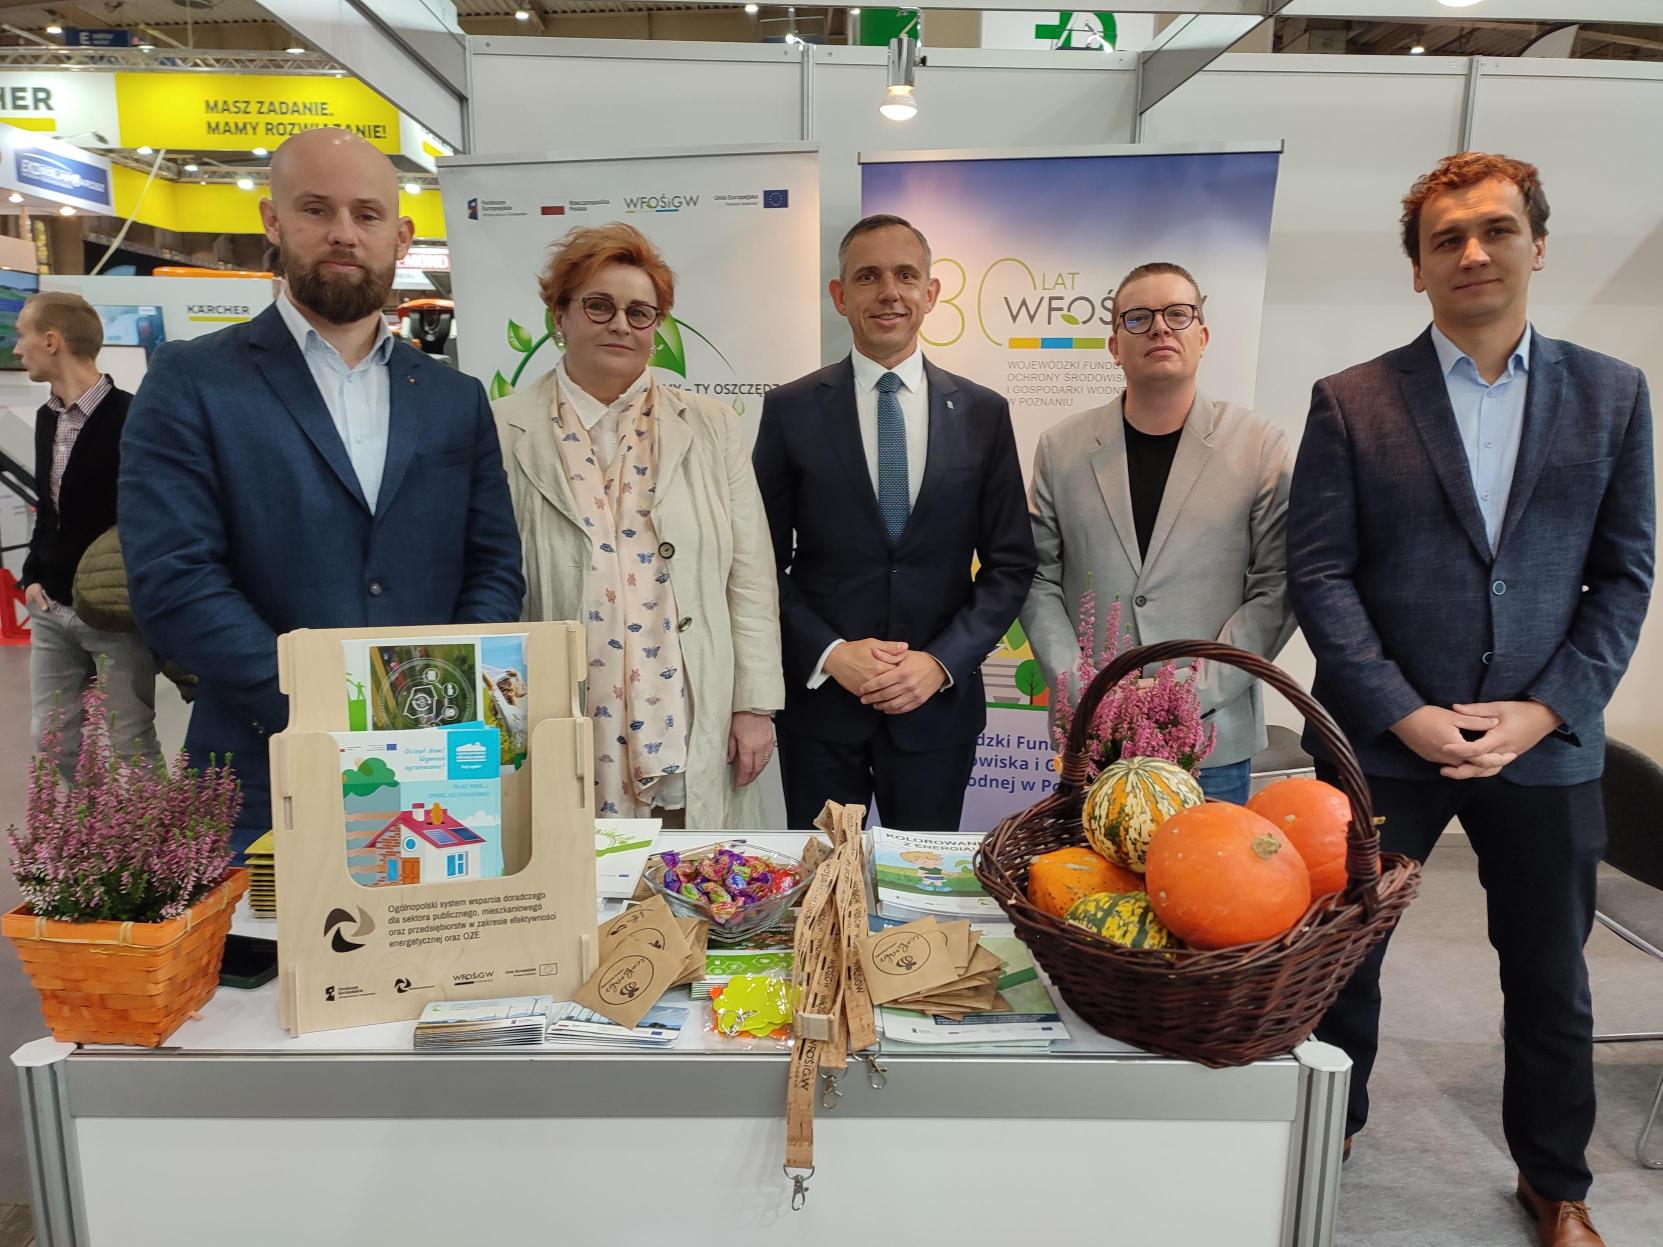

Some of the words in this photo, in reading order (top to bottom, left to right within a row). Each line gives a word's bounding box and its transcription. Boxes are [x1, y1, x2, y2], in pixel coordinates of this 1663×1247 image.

[205, 100, 251, 115] MASZ
[256, 101, 334, 116] ZADANIE.
[207, 121, 259, 136] MAMY
[1042, 272, 1080, 291] LAT
[1008, 359, 1080, 370] WOJEWÓDZKI
[1007, 372, 1060, 383] OCHRONY
[695, 383, 710, 394] TY
[1012, 385, 1084, 395] GOSPODARKI
[1019, 397, 1074, 408] POZNANIU
[1017, 735, 1055, 751] Fun
[1035, 757, 1040, 771] i
[1020, 779, 1036, 792] w
[387, 901, 438, 915] Ogólnopolski
[439, 898, 467, 910] system
[468, 896, 502, 906] wsparcia
[503, 891, 546, 902] doradczego
[388, 916, 400, 925] dla
[402, 913, 431, 923] sektora
[481, 903, 543, 917] mieszkaniowego
[388, 928, 406, 937] oraz
[407, 920, 467, 936] przedsiębiorstw
[468, 921, 476, 930] w
[476, 917, 508, 928] zakresie
[509, 911, 557, 926] efektywności
[388, 934, 443, 949] energetycznej
[444, 933, 461, 943] oraz
[463, 930, 481, 940] OZE
